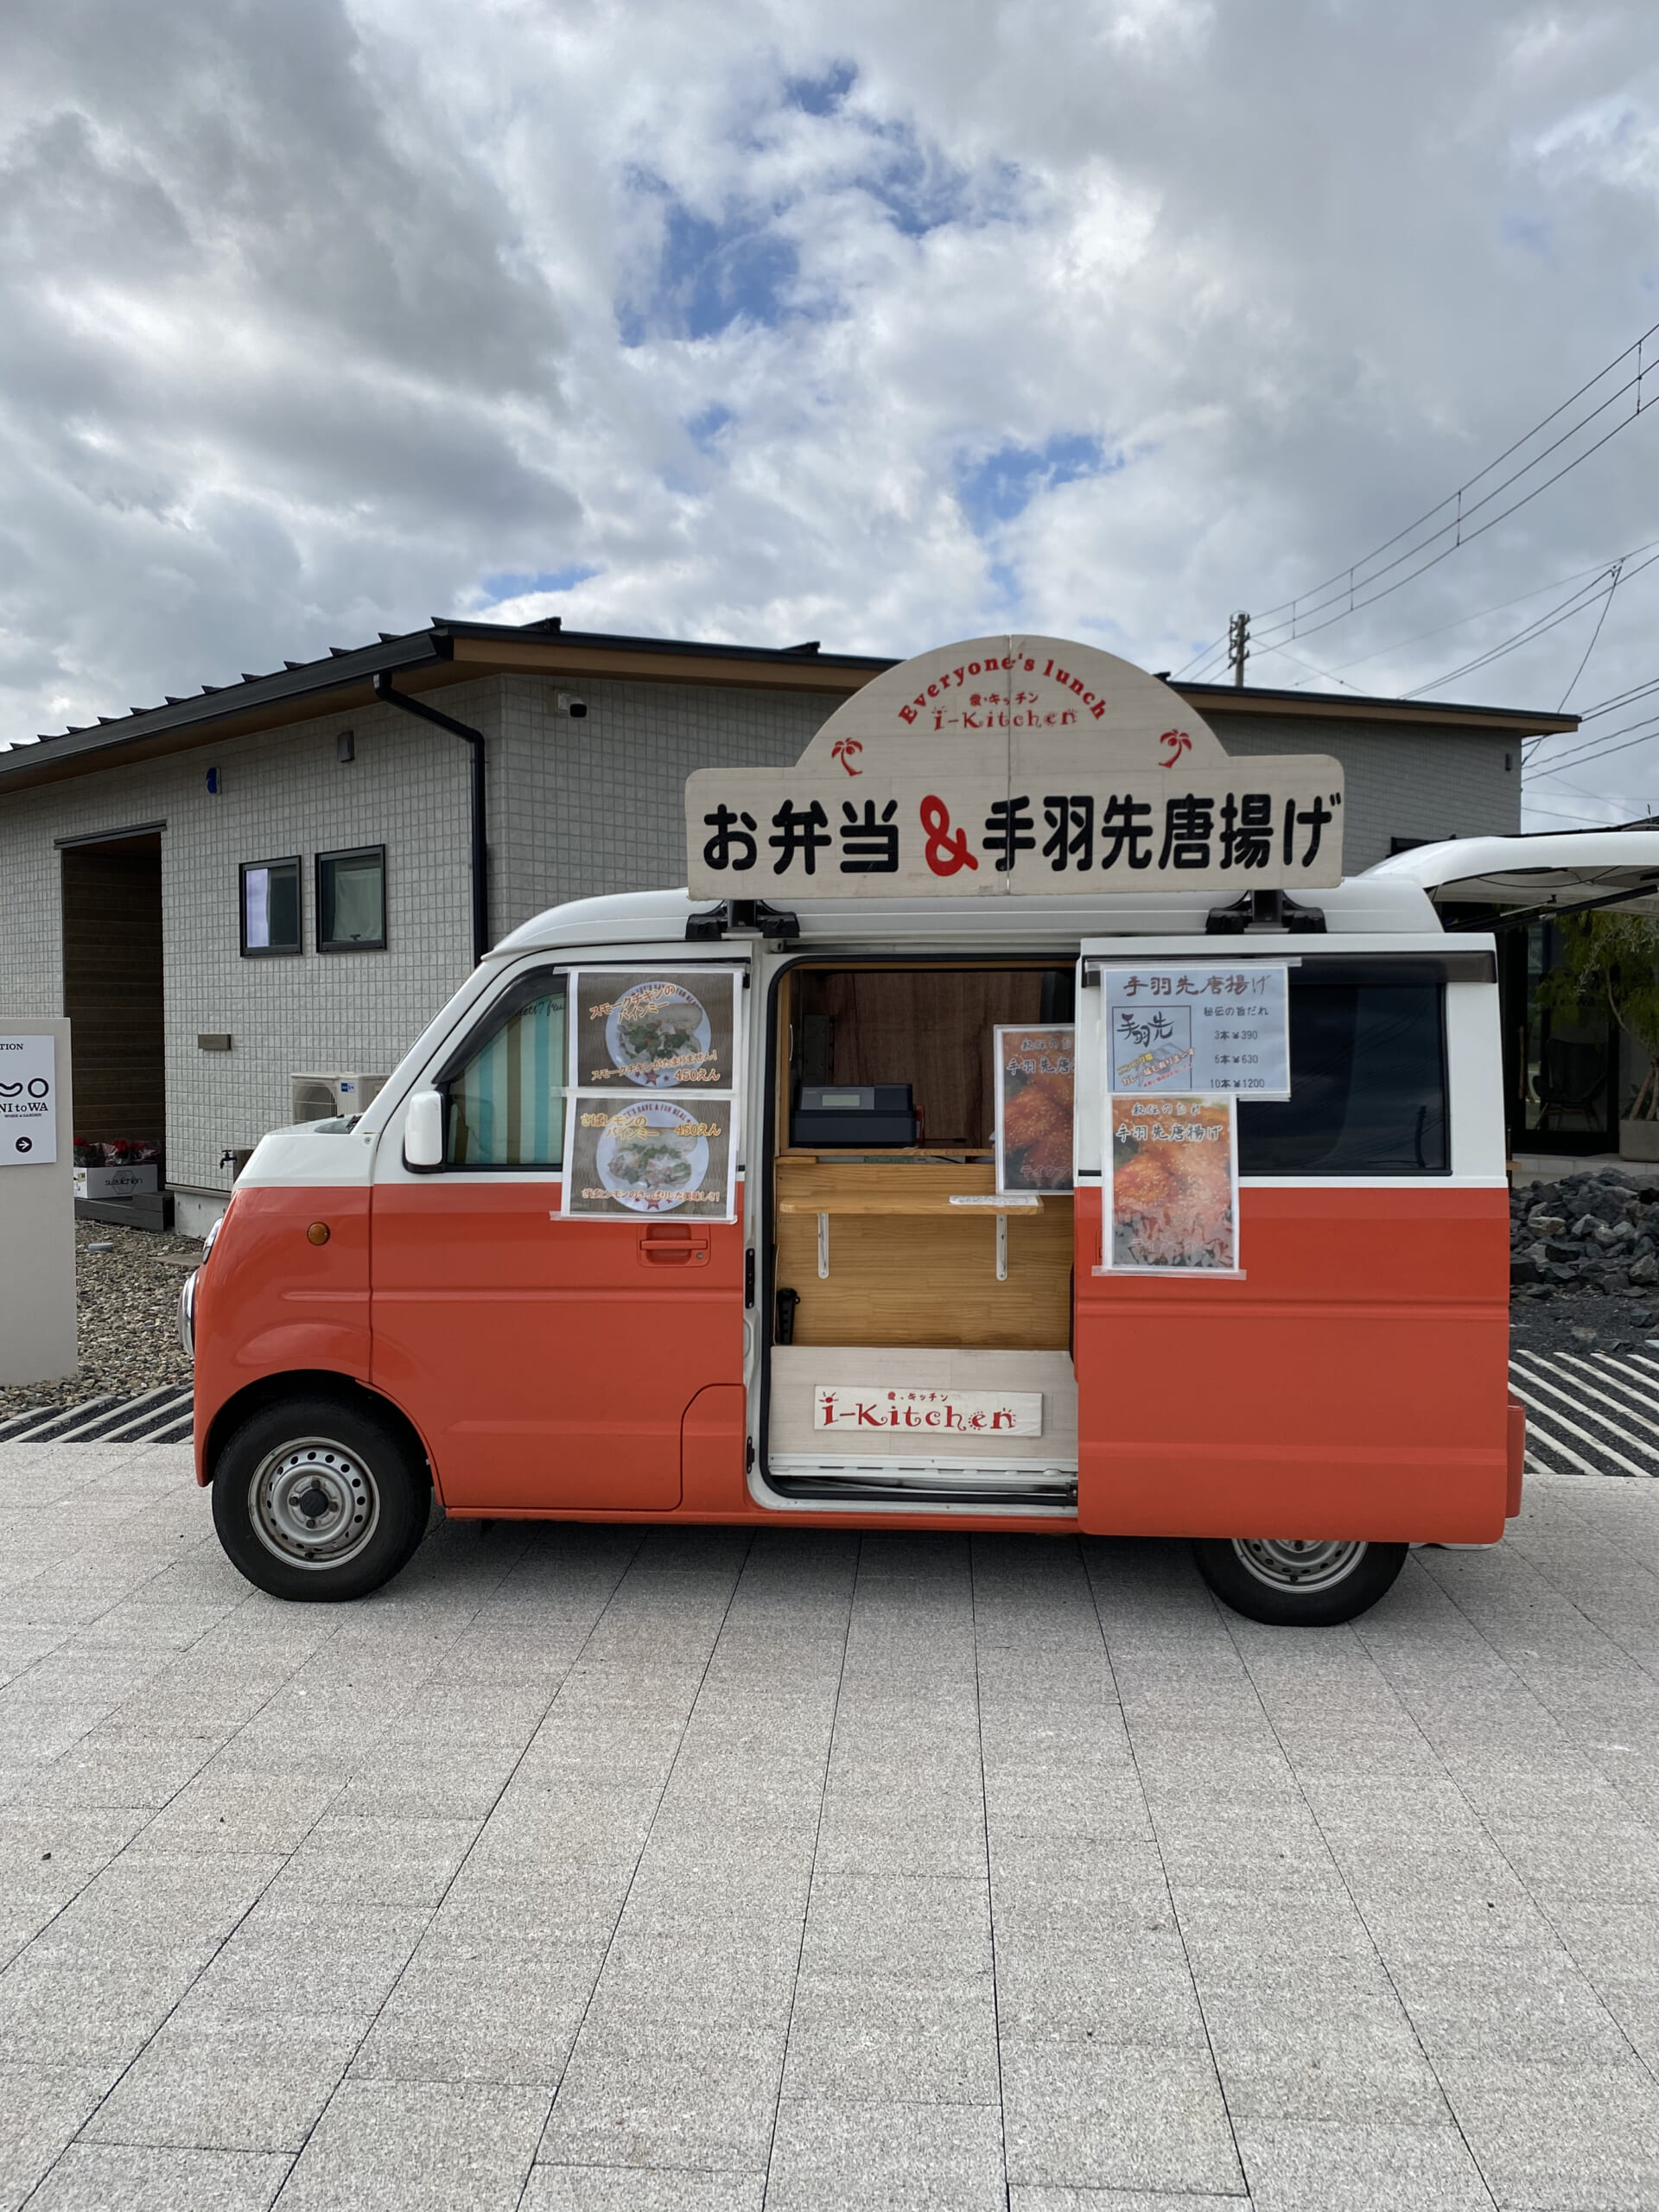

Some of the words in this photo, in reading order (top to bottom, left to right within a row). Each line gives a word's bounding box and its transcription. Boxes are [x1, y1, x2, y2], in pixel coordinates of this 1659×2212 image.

[898, 652, 1036, 725] Everyone's
[1042, 659, 1107, 720] lunch
[1122, 974, 1272, 996] 手羽先唐揚げ
[589, 984, 677, 1020] スモークチキンの
[1116, 1010, 1175, 1048] 手羽先
[674, 1069, 721, 1082] 450えん
[1007, 1056, 1075, 1076] 手羽先唐
[674, 1122, 721, 1137] 450えん
[1116, 1123, 1224, 1143] 手羽先唐揚げ
[819, 1392, 1017, 1432] i-Kitchen
